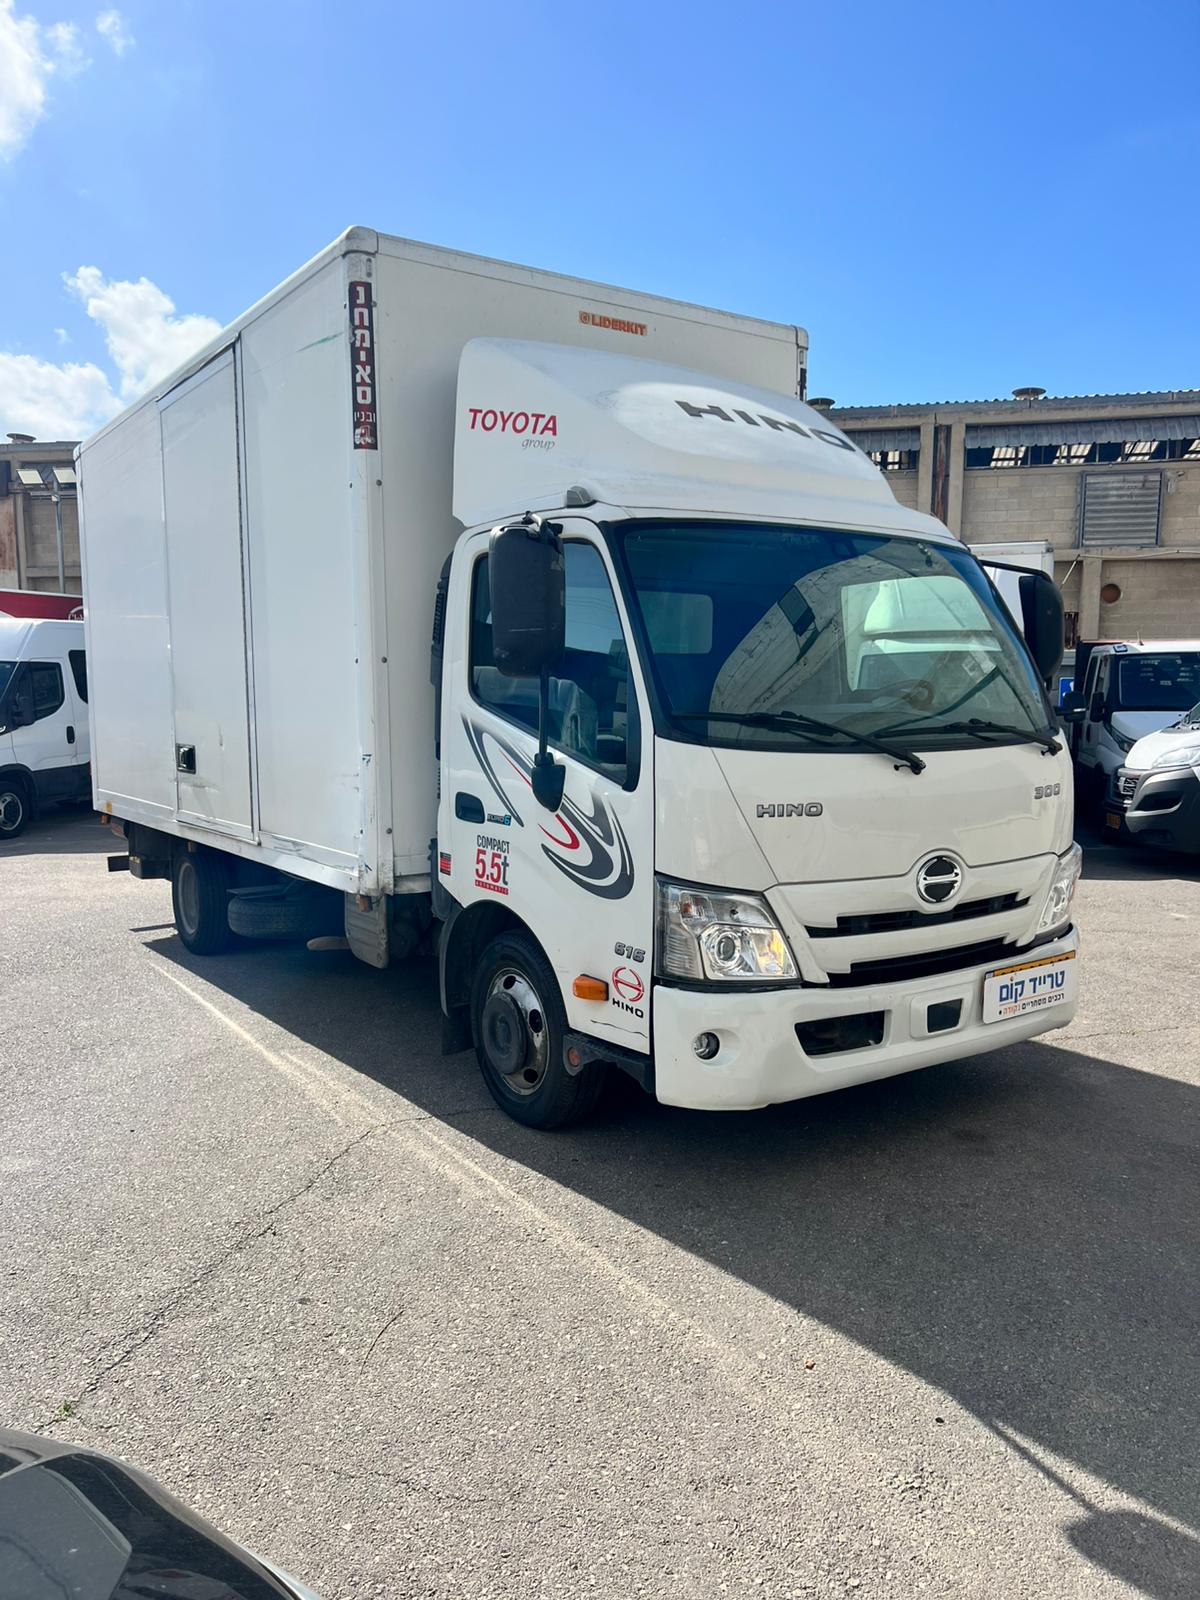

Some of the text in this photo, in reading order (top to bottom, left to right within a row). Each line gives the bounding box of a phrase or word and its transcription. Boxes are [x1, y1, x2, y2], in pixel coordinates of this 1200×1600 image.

[591, 313, 647, 336] LIDERKIT
[353, 286, 372, 404] נחמיאס
[354, 411, 376, 423] ובניו
[469, 408, 557, 436] TOYOTA
[675, 400, 857, 452] HINO
[521, 439, 555, 452] group
[1034, 782, 1061, 800] 300
[756, 802, 824, 818] HINO
[476, 834, 510, 854] COMPACT
[475, 847, 510, 886] 5.5t
[614, 941, 646, 964] 616
[999, 970, 1066, 1004] טרייד קום
[612, 997, 644, 1019] HINO
